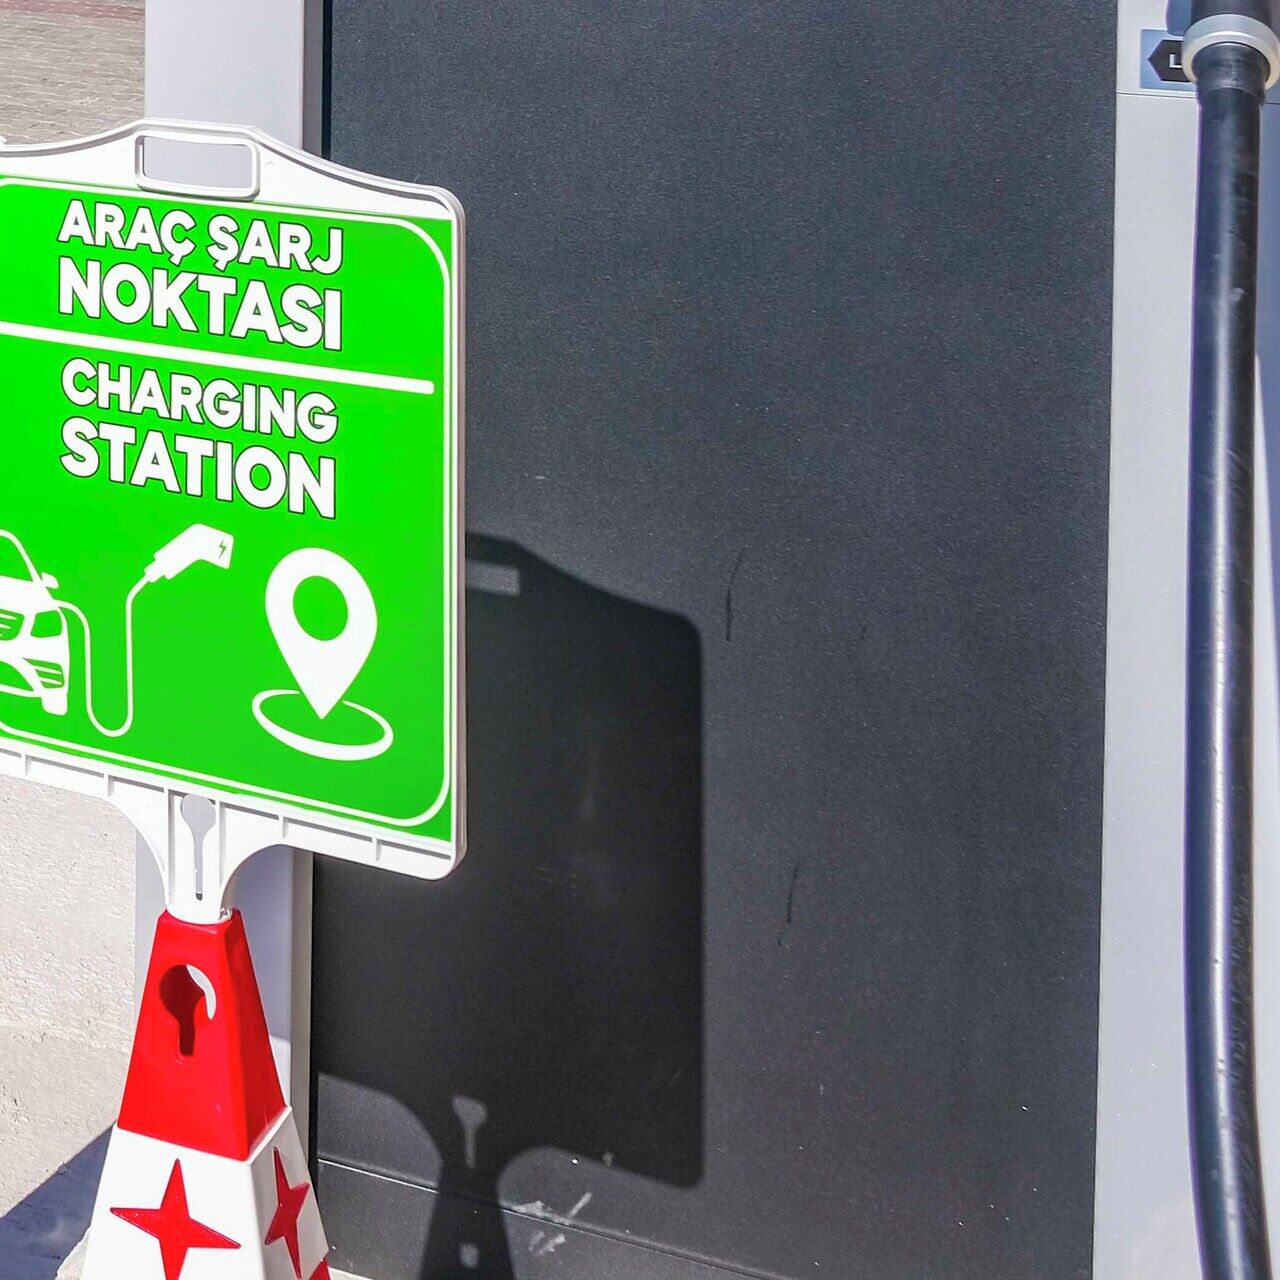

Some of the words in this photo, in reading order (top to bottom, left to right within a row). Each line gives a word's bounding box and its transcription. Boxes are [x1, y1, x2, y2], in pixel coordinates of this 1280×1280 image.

[57, 198, 197, 267] ARAÇ
[206, 213, 344, 275] ŞARJ
[58, 255, 343, 352] NOKTASI
[60, 356, 339, 444] CHARGING
[59, 415, 337, 520] STATION
